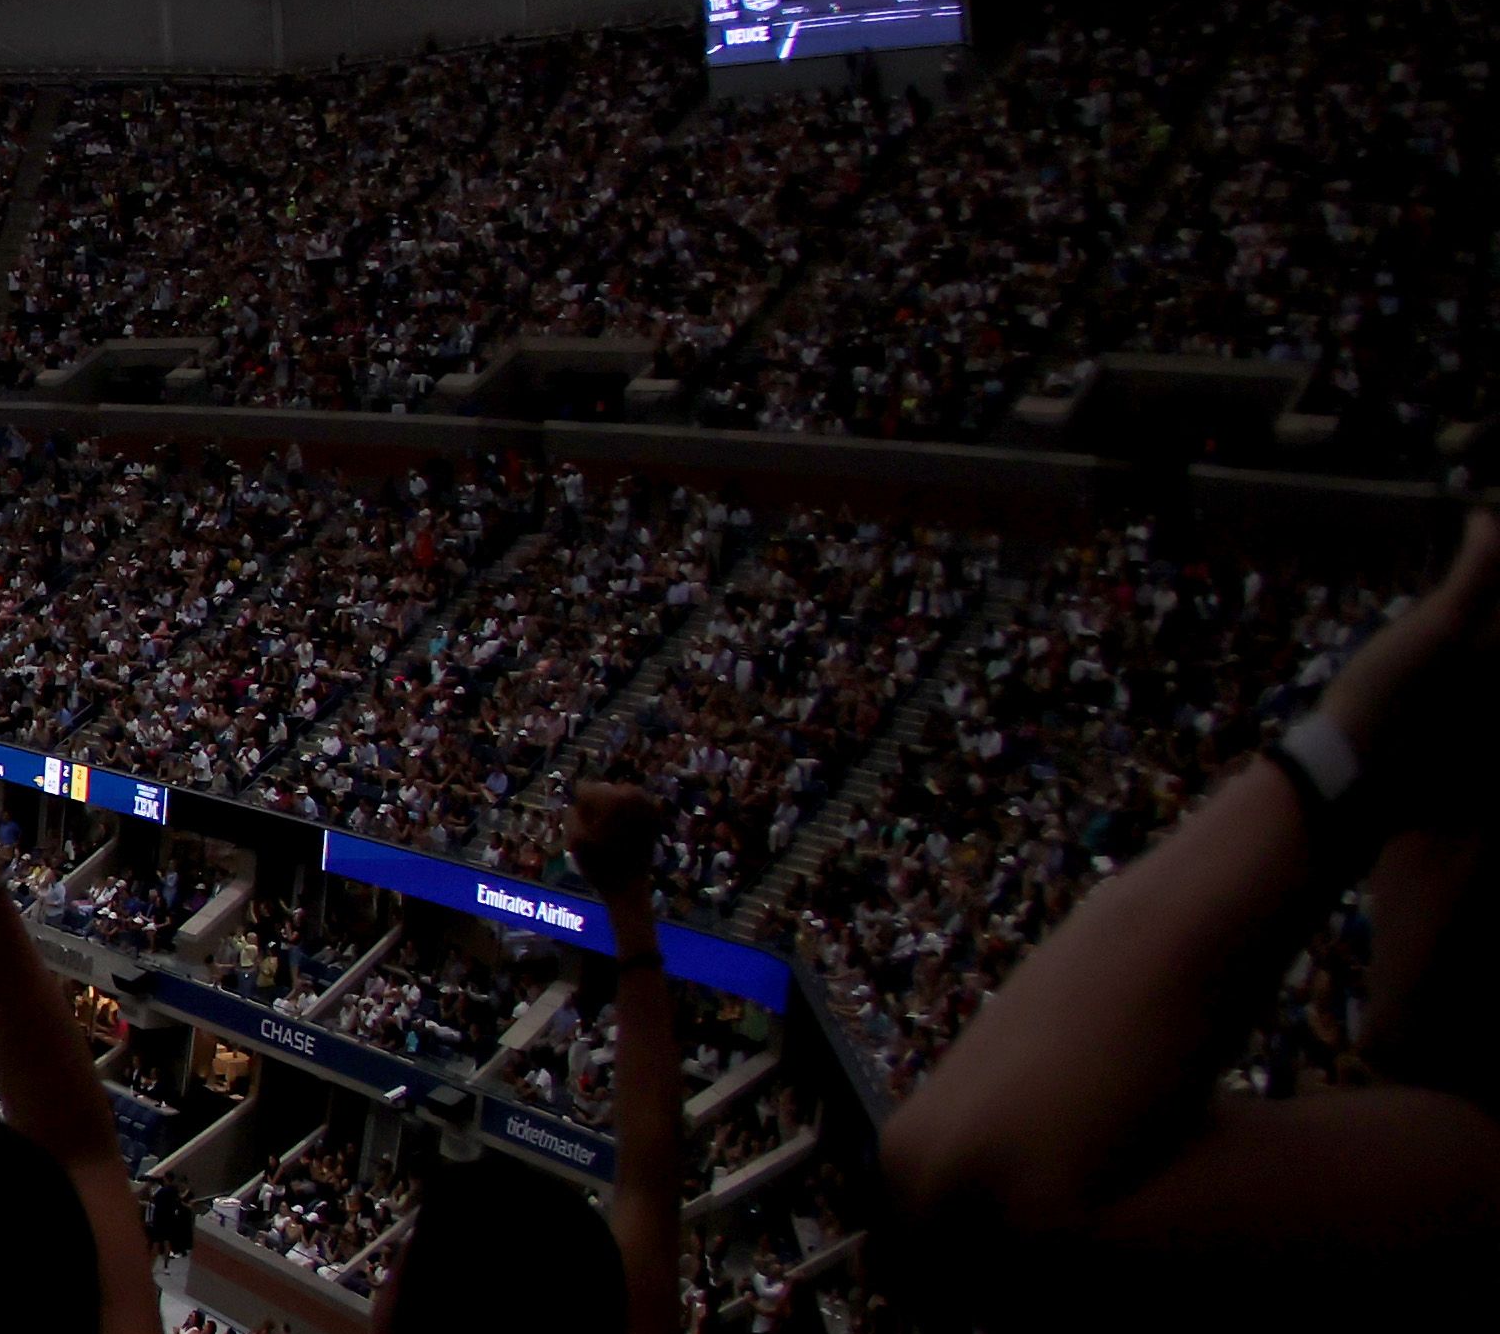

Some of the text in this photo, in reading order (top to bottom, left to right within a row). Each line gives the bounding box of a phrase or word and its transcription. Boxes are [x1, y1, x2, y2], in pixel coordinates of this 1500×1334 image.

[63, 765, 70, 778] 2
[133, 795, 160, 820] IBM
[476, 882, 584, 932] Emirates Airline
[260, 1018, 315, 1056] CHASE
[507, 1115, 596, 1167] ticketmaster
